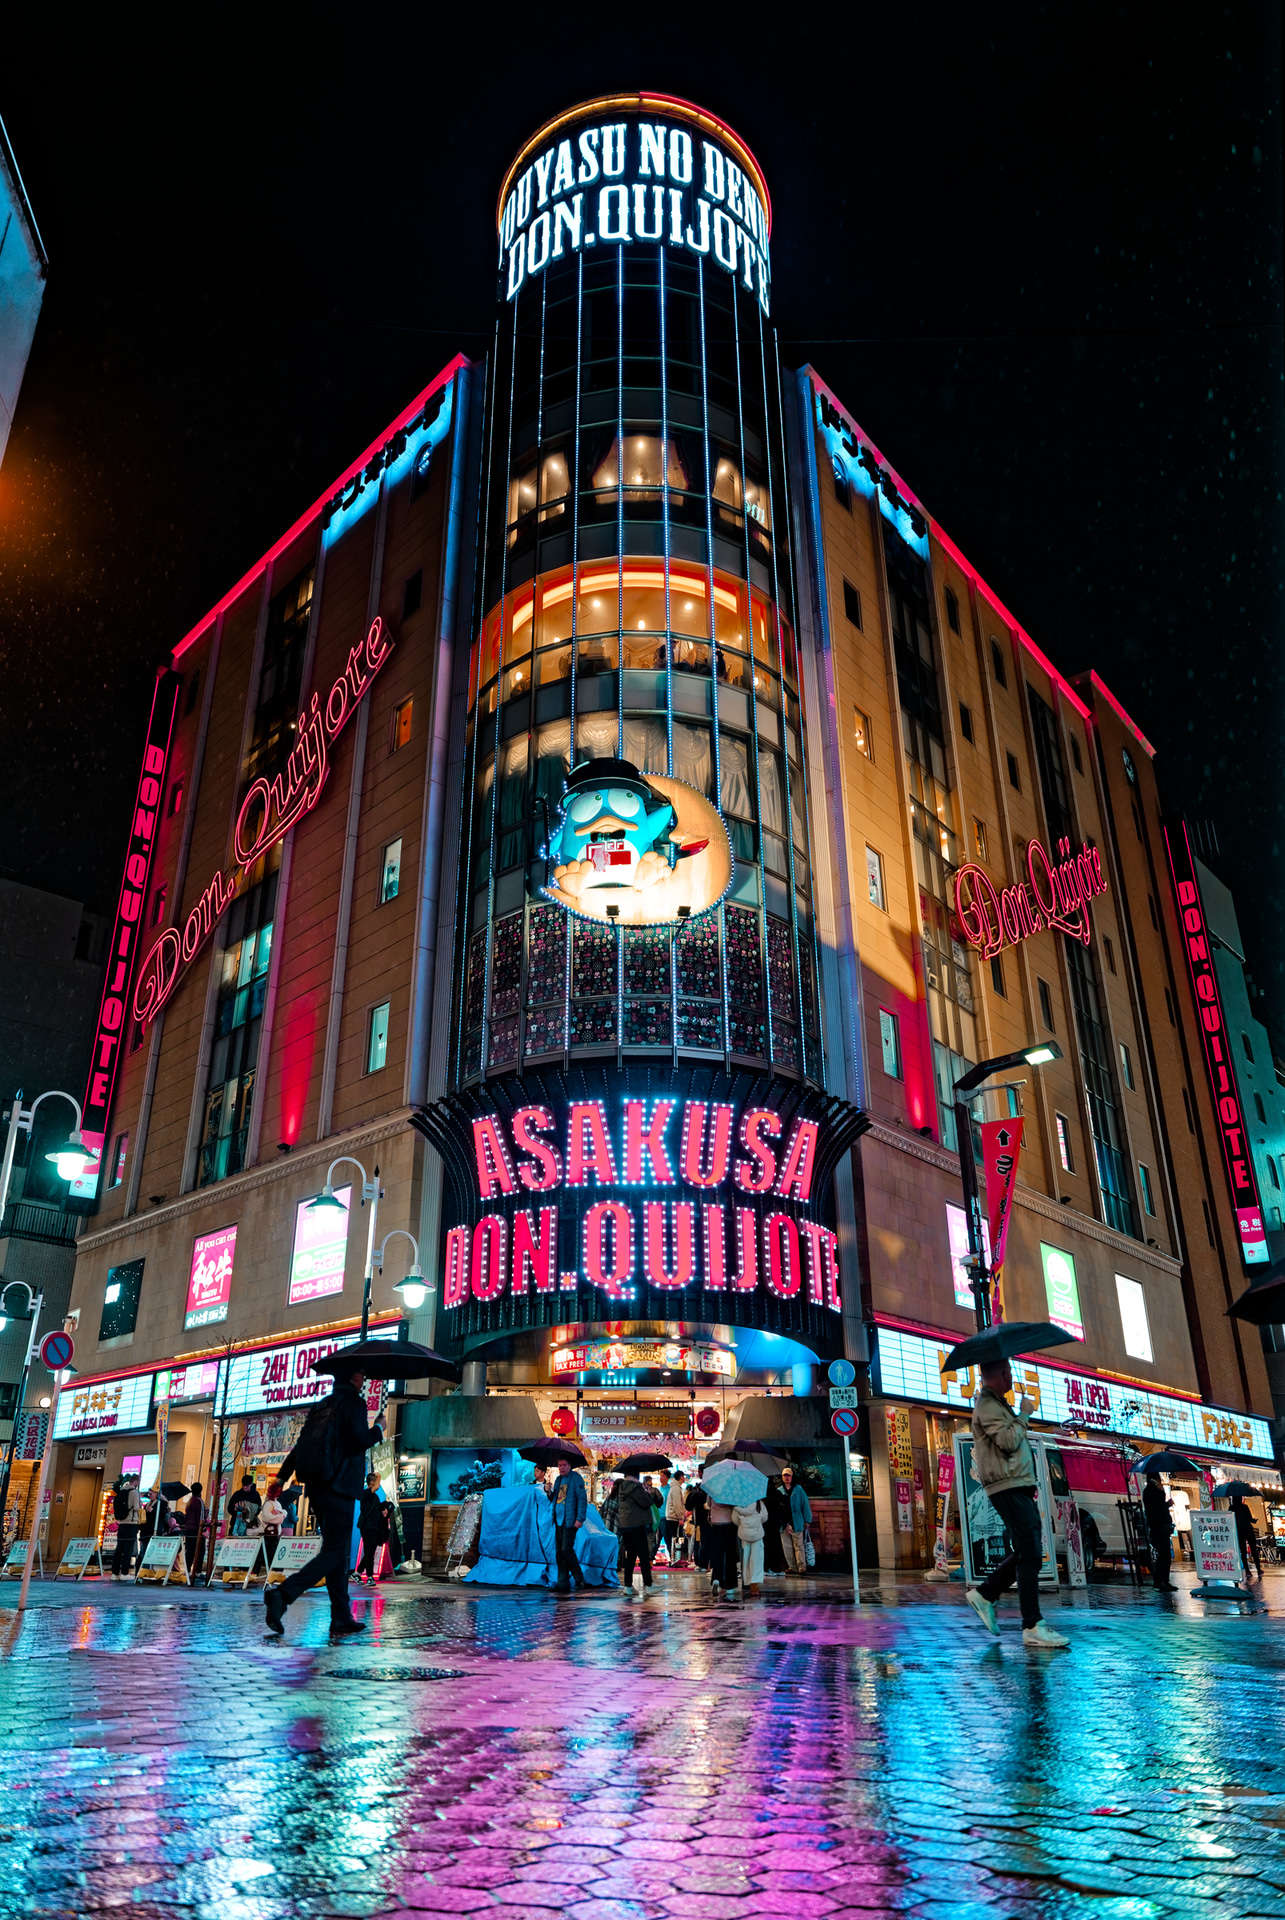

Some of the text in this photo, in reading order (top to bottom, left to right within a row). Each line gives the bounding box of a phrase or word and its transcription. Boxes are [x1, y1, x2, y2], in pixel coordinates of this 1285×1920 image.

[637, 122, 693, 184] NO
[472, 1098, 820, 1203] ASAKUSA
[195, 1231, 238, 1252] All you can eat
[443, 1199, 842, 1314] DON.QUIJOTE
[192, 1247, 232, 1300] 和牛
[260, 1351, 290, 1386] 24H
[555, 1359, 584, 1371] TAX FREE
[1064, 1377, 1084, 1405] 24H
[1085, 1382, 1111, 1411] OPEN
[23, 1414, 41, 1460] 六区花道
[70, 1416, 98, 1432] ASAKUSA
[1198, 1525, 1230, 1533] SAKURA
[1202, 1560, 1235, 1572] 通行禁止
